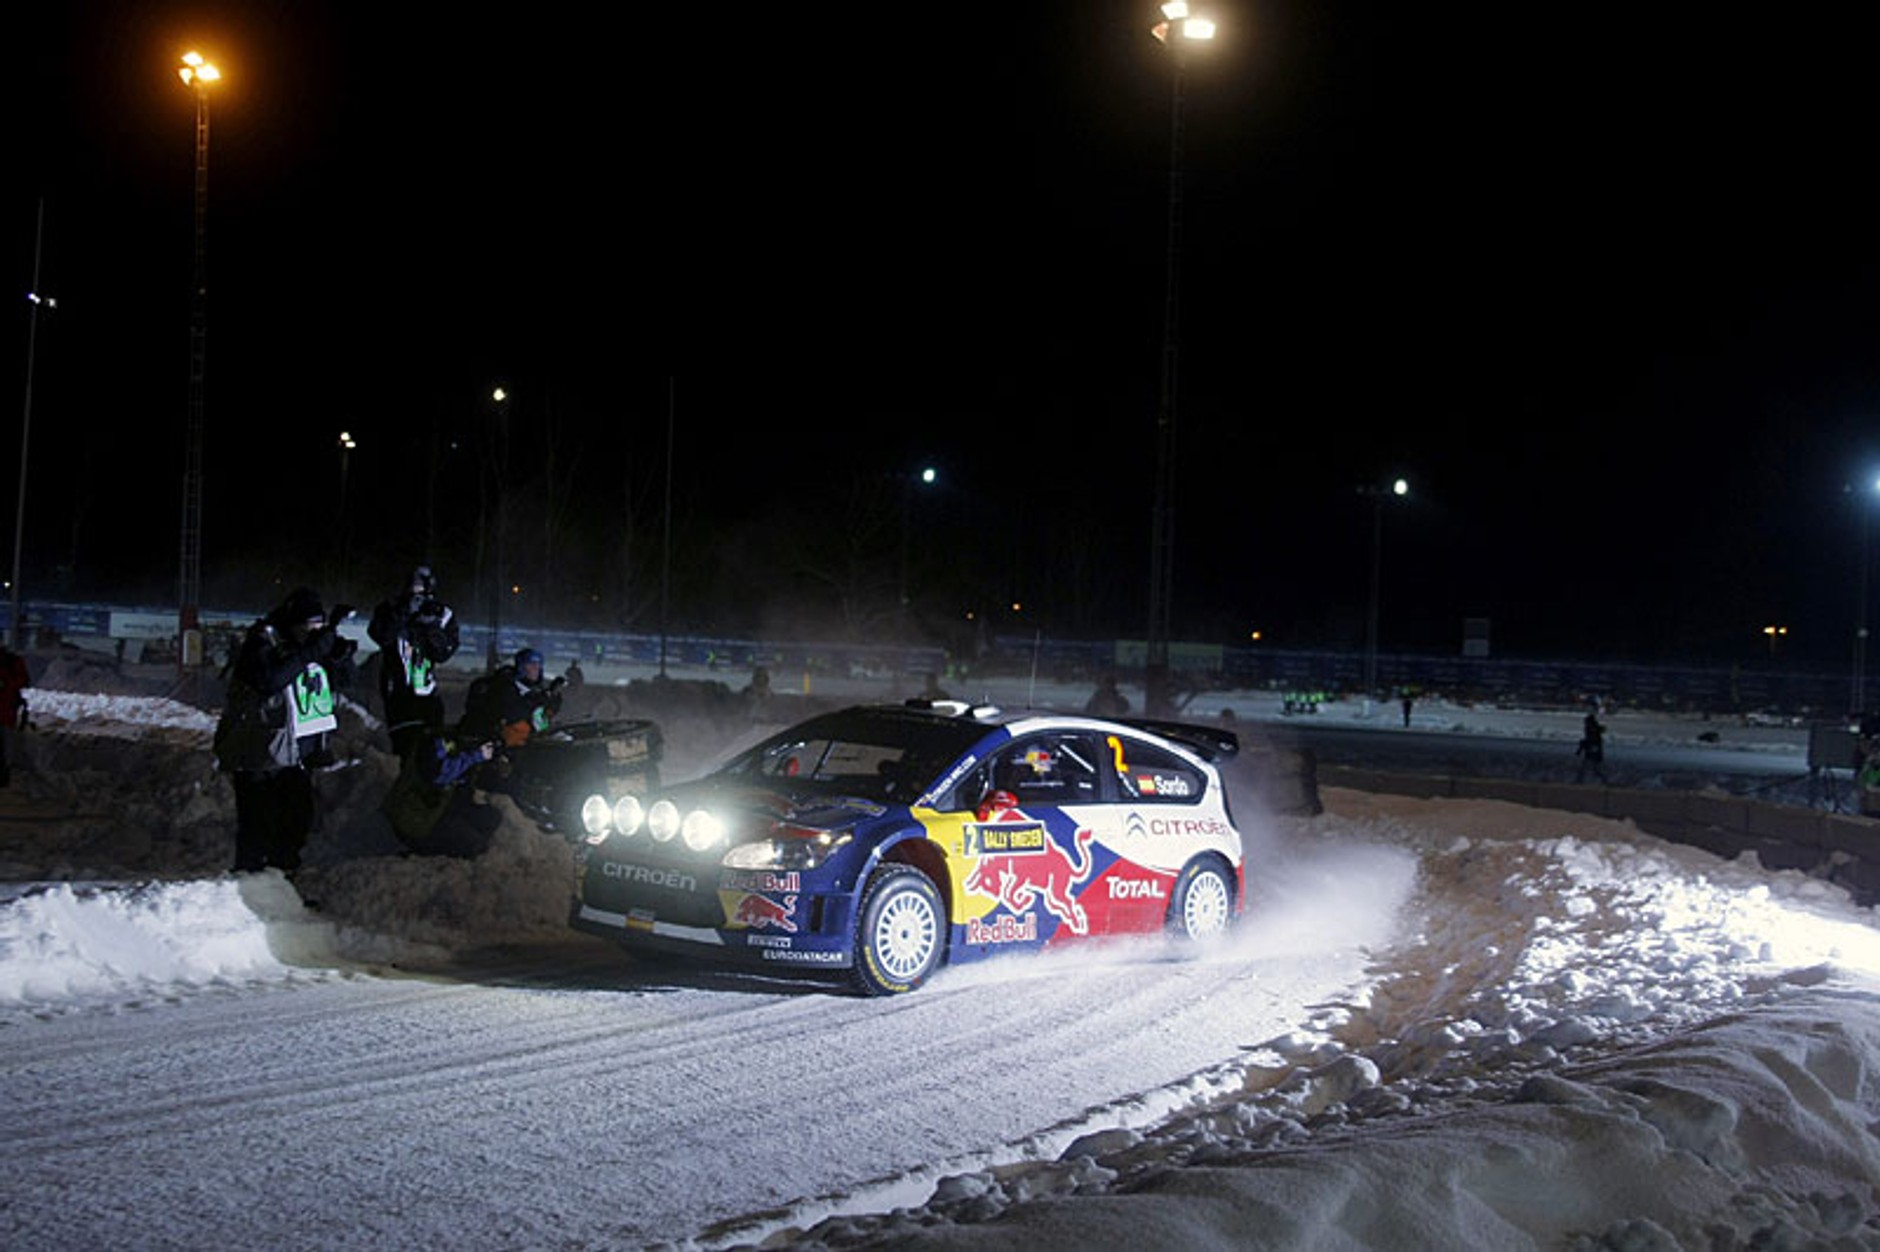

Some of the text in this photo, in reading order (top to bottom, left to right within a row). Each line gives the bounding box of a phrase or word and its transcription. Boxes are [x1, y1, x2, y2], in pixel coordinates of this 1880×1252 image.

[1107, 736, 1129, 772] 2
[763, 871, 800, 893] Bull
[1106, 876, 1166, 899] TOTAL
